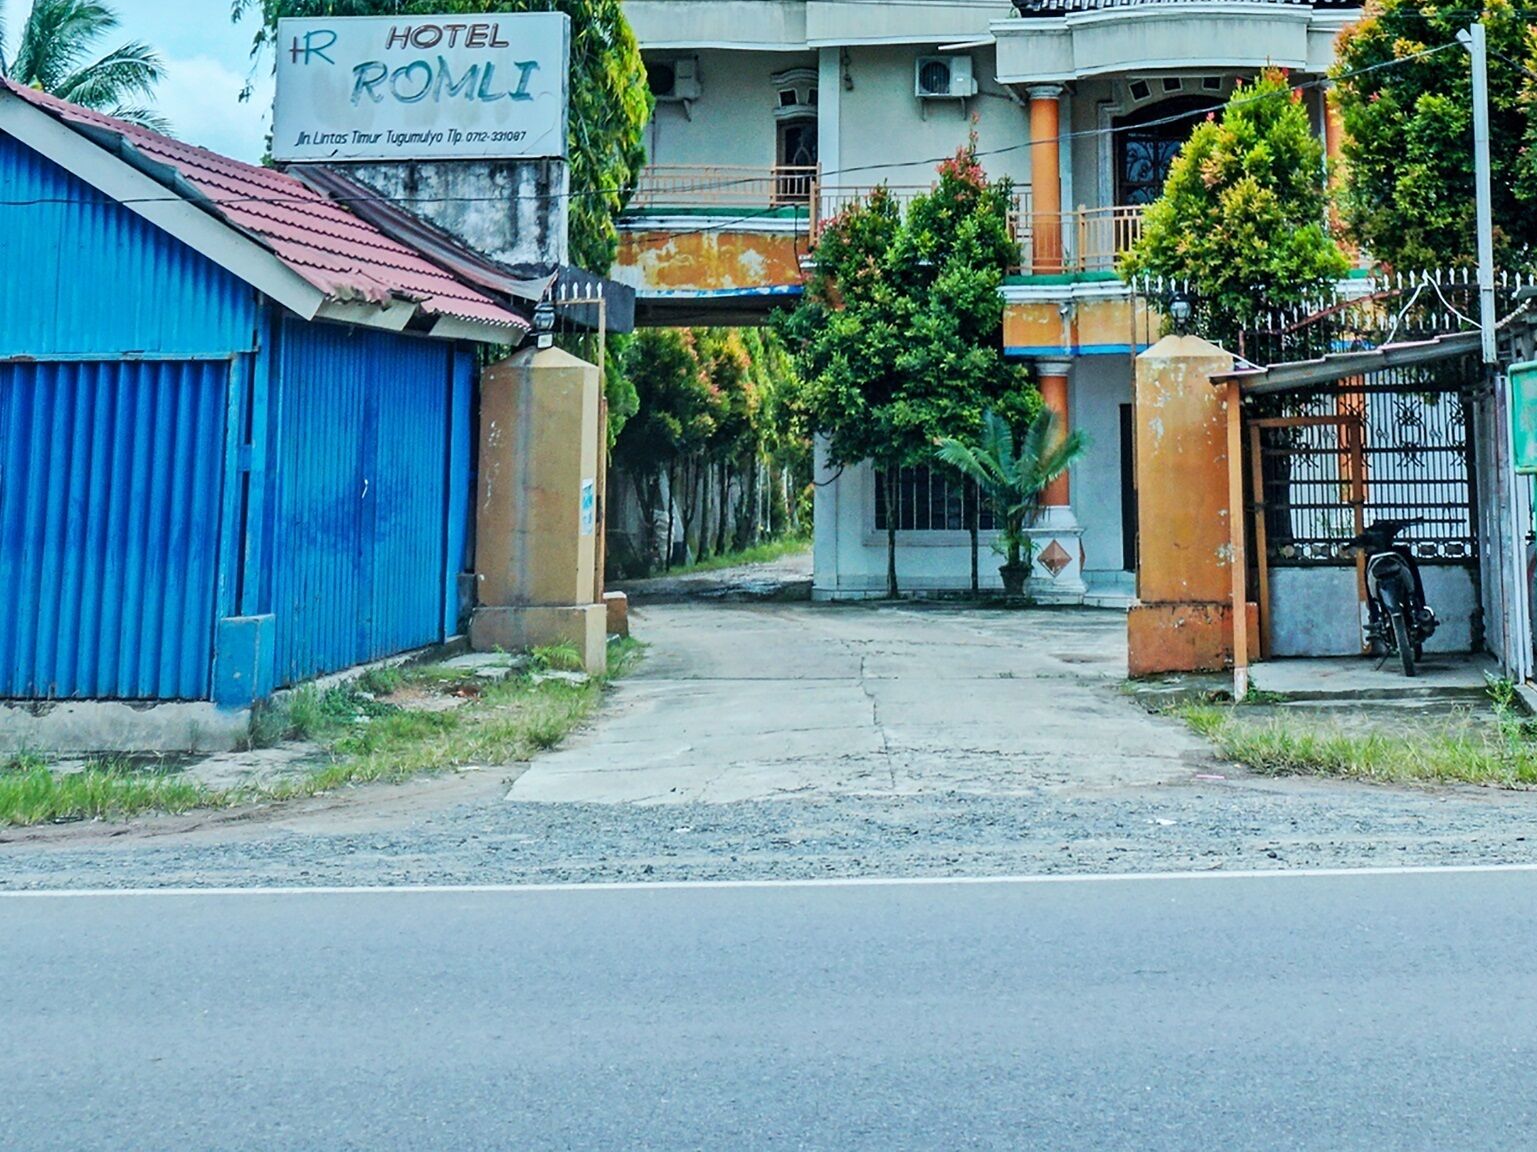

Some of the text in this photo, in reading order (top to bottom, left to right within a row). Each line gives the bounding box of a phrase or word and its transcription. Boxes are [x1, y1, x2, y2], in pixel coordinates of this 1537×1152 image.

[385, 23, 509, 50] HOTEL
[350, 55, 541, 107] ROMLI
[313, 131, 348, 145] Lintas
[351, 130, 383, 144] Timur
[386, 129, 443, 146] Tugumulyo
